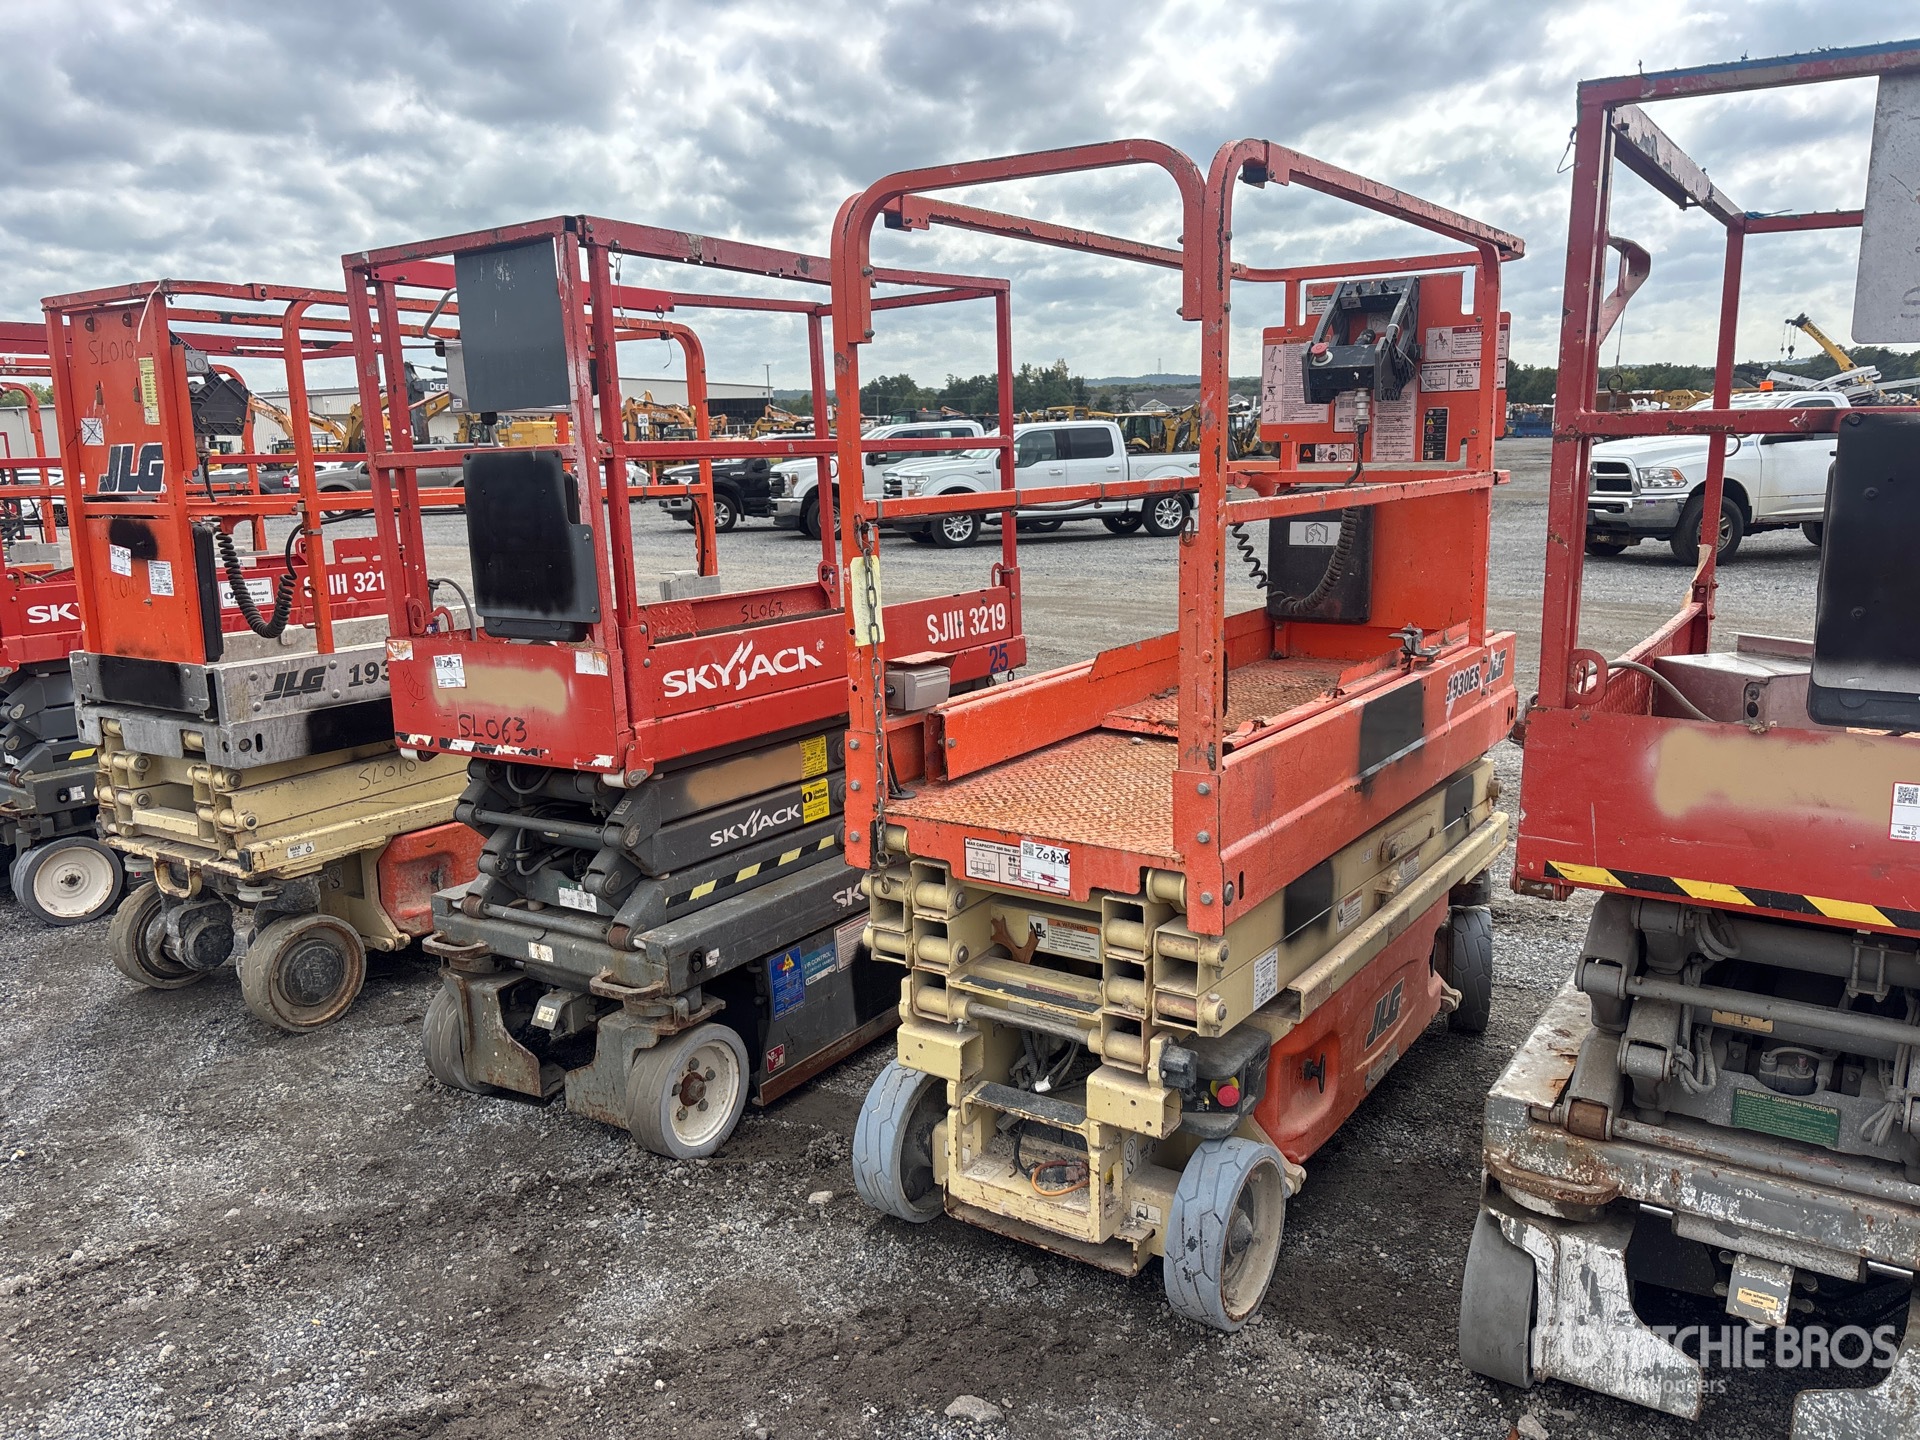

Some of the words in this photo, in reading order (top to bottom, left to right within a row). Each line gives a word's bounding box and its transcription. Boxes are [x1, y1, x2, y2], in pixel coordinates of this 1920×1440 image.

[1807, 322, 1826, 341] GROVE
[88, 340, 134, 365] SL010
[97, 442, 165, 494] JLG
[27, 603, 80, 624] SK
[741, 600, 784, 622] SL063
[969, 603, 1006, 636] 3219
[662, 639, 823, 698] SKYJACK
[989, 643, 1009, 674] 25
[263, 666, 326, 701] JLG
[1446, 663, 1481, 703] 1930ES
[458, 714, 528, 744] SL063
[359, 760, 417, 791] SL010
[710, 804, 801, 847] SKYJACK
[1062, 921, 1088, 932] WARNING
[1364, 977, 1405, 1051] JLG
[1736, 1088, 1771, 1101] EMERGENCY
[1771, 1096, 1802, 1107] LOWERING
[1802, 1102, 1838, 1115] PROCEDURE
[1752, 1293, 1775, 1304] wheeling
